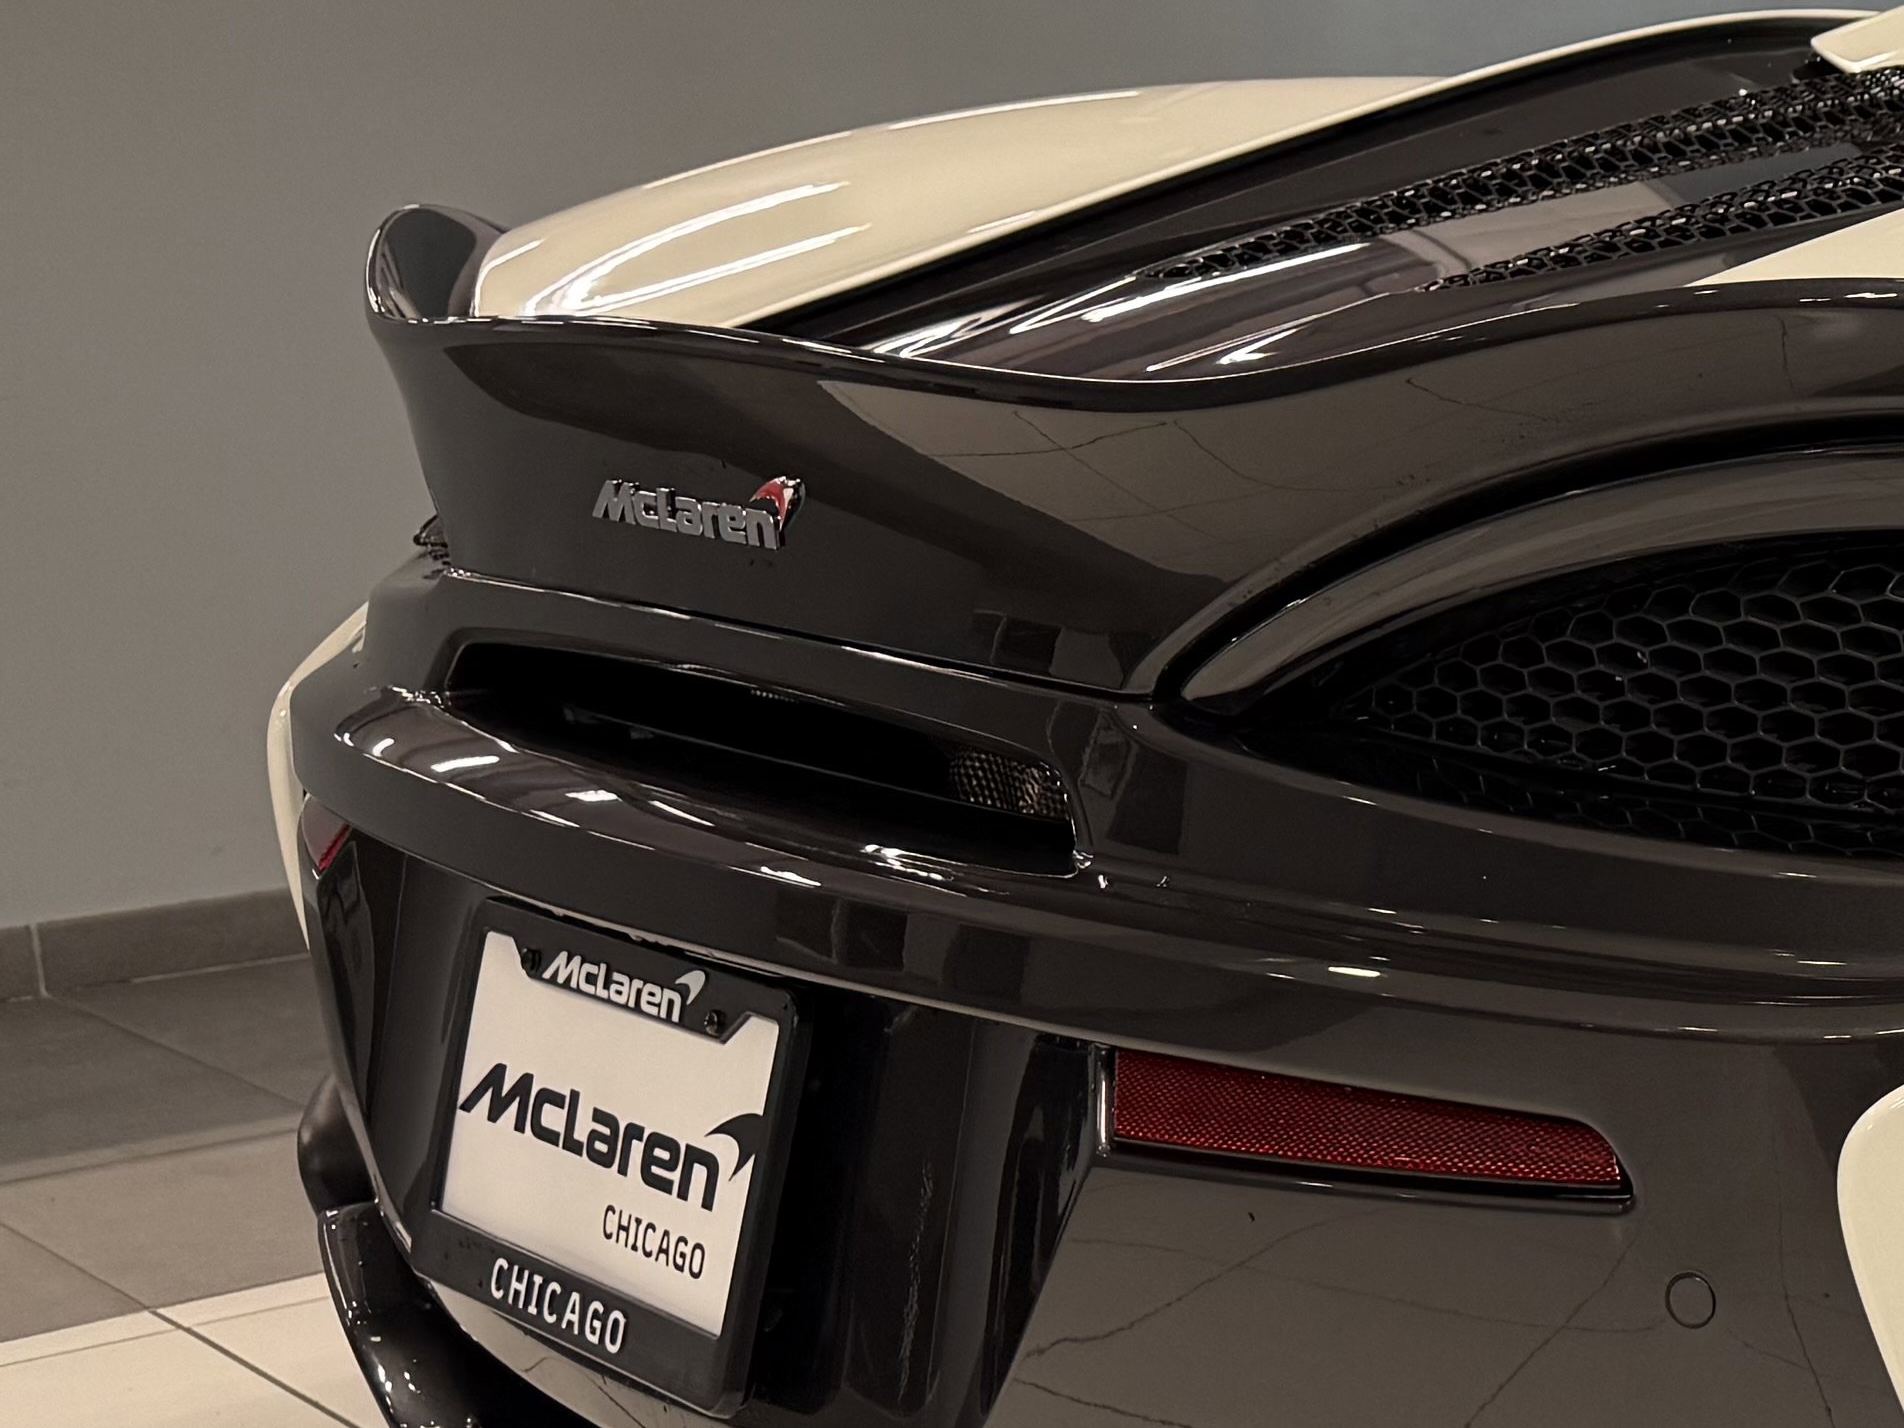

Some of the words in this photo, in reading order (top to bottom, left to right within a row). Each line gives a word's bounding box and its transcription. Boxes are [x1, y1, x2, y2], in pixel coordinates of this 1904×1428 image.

[592, 478, 782, 551] McLaren
[542, 949, 683, 1023] McLaren
[459, 1062, 721, 1212] McLaren
[601, 1204, 706, 1280] CHICAGO
[490, 1257, 627, 1355] CHICAGO
